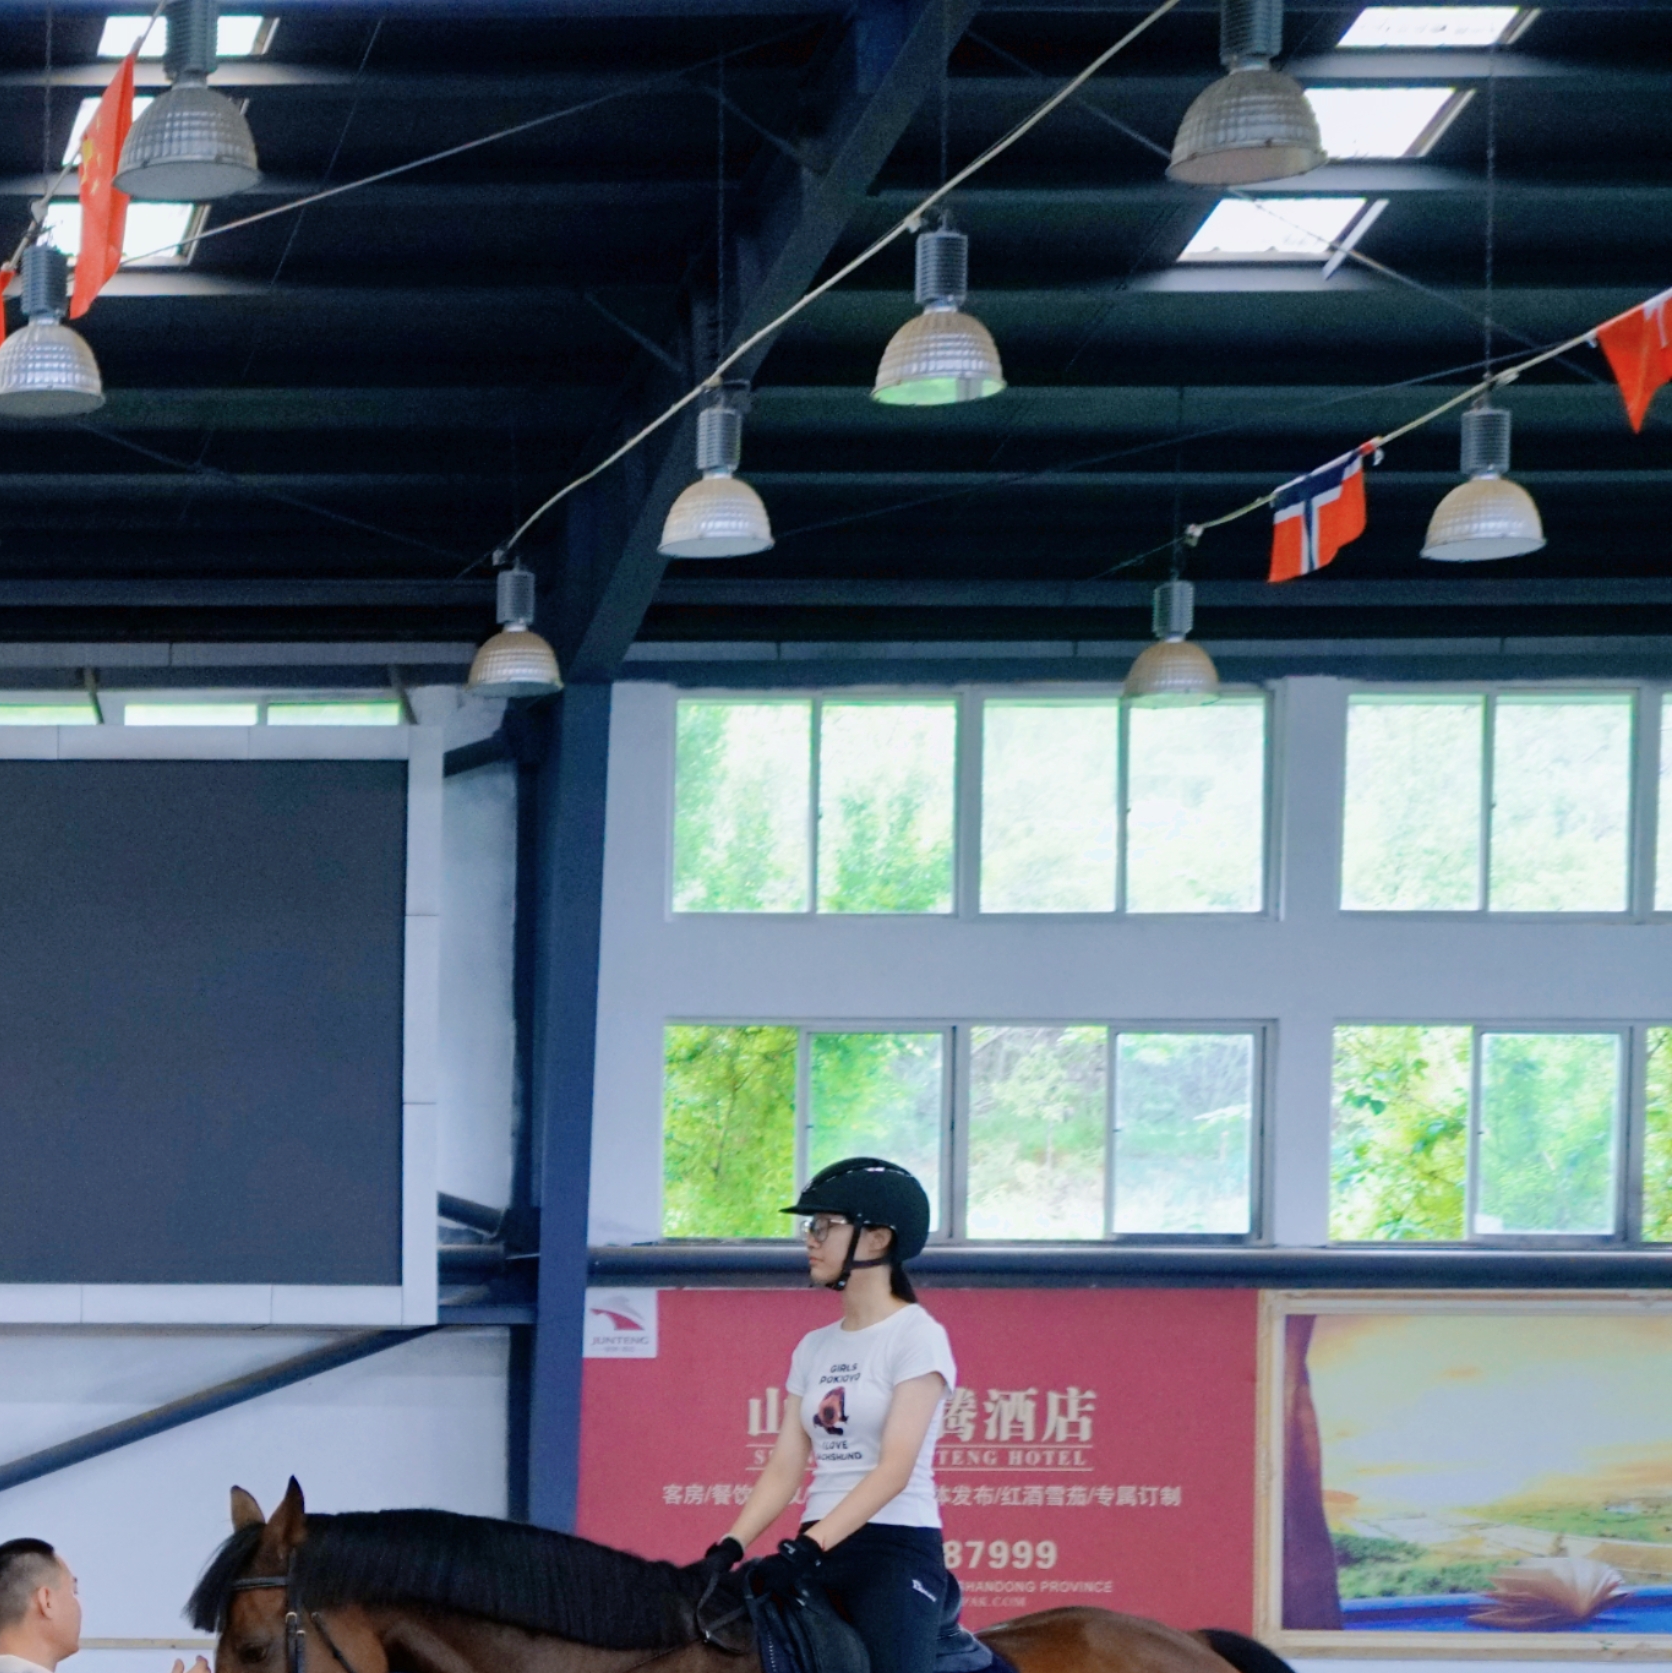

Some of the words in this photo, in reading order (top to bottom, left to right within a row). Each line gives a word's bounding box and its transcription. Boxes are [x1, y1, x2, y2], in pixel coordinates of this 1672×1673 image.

[1008, 1450, 1086, 1466] HOTEL
[943, 1539, 1057, 1569] 87999
[1039, 1581, 1113, 1593] PROVINCE
